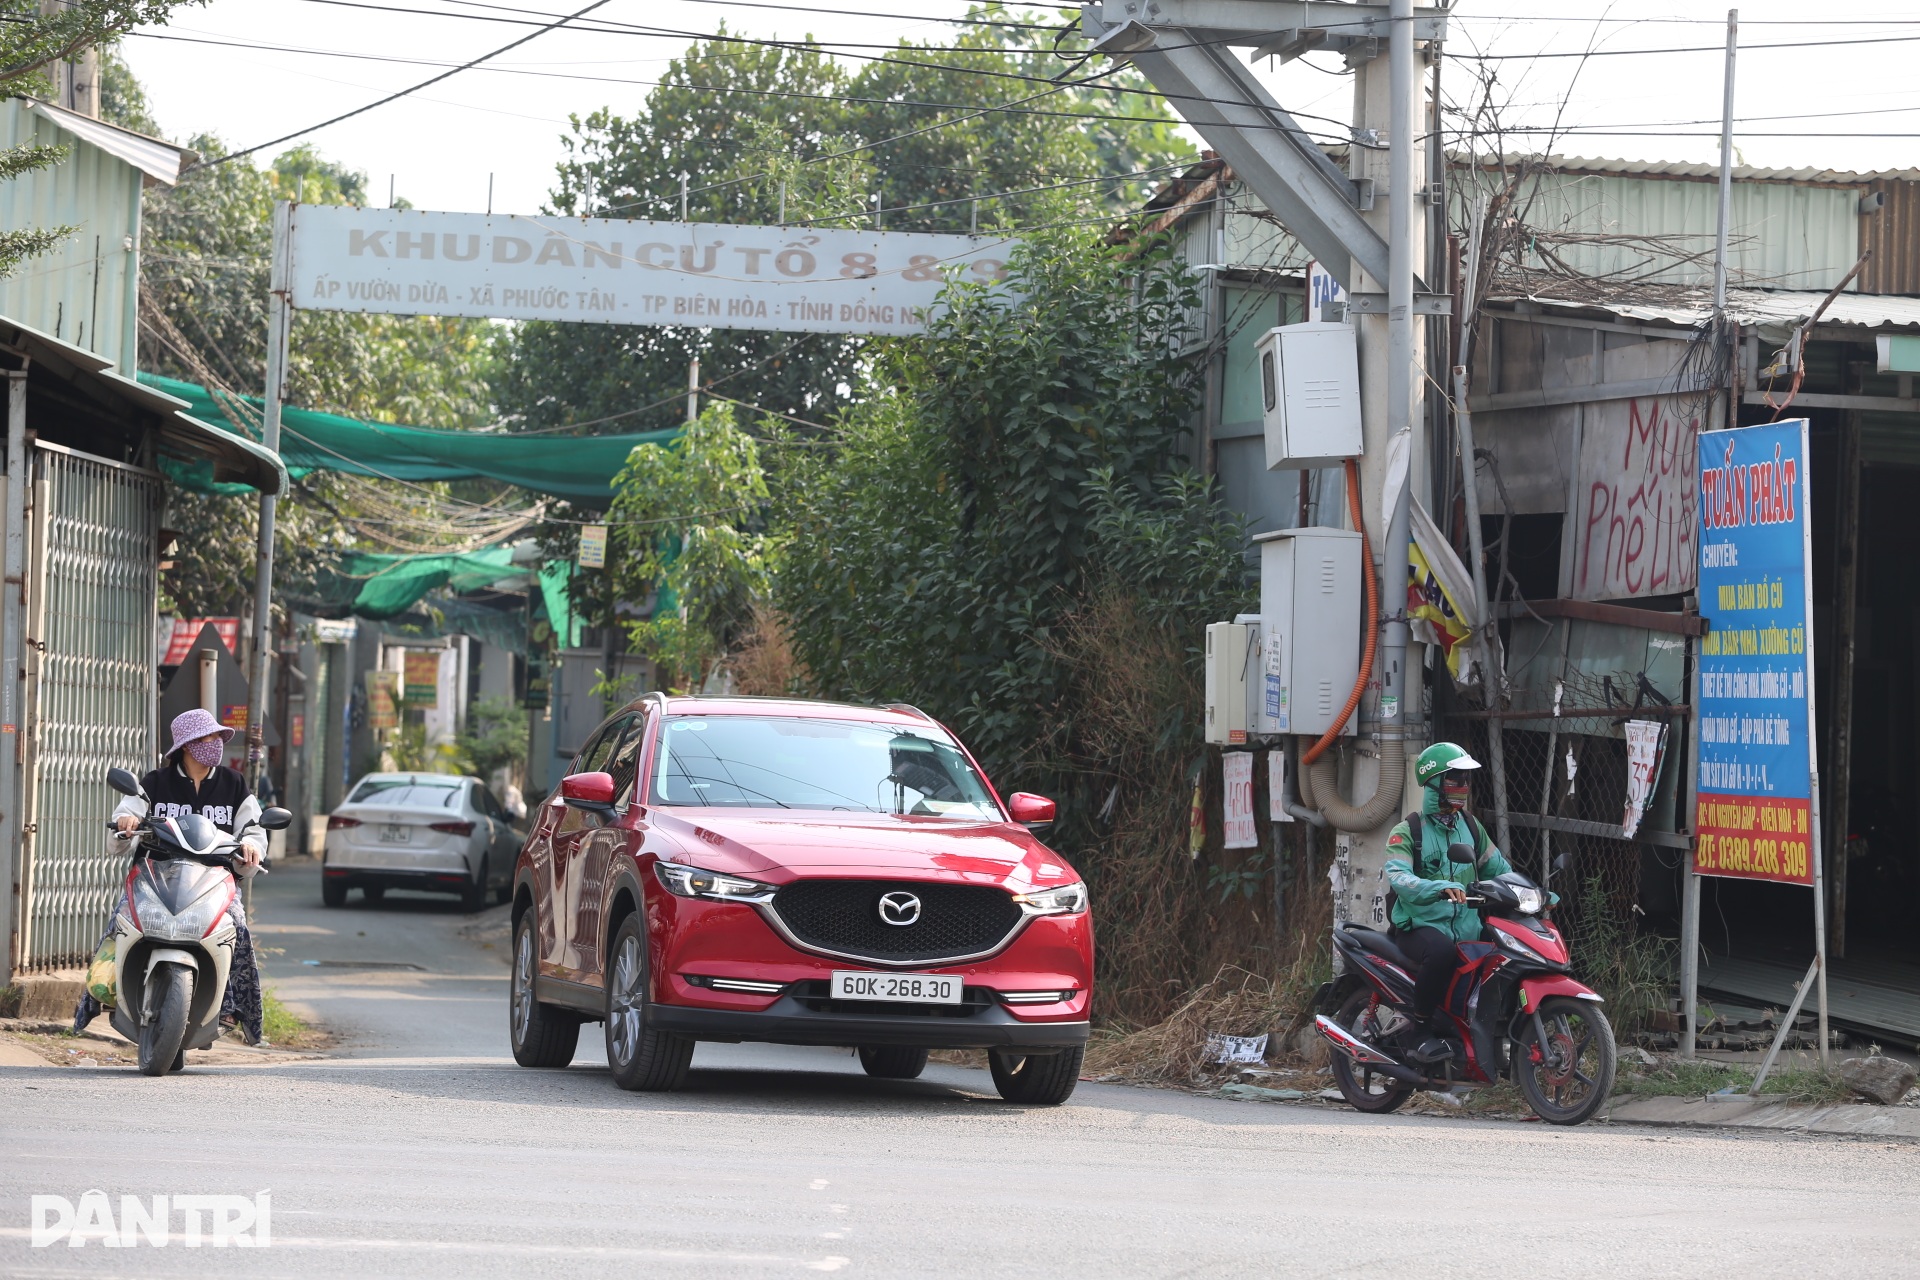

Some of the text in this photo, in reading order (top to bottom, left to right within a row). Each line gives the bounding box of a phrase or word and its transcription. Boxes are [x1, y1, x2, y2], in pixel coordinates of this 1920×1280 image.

[349, 228, 481, 262] KHU
[491, 231, 623, 270] DÂN
[634, 239, 726, 275] CƯ
[733, 236, 821, 278] TỔ
[839, 252, 879, 280] 8
[901, 254, 945, 282] &
[313, 273, 341, 300] ẤP
[347, 277, 401, 303] VƯỜN
[408, 278, 450, 304] DỪA
[469, 282, 495, 307] XÃ
[502, 284, 570, 311] PHƯỚC
[576, 287, 616, 312] TÂN
[641, 294, 668, 314] TP
[673, 292, 721, 317] BIÊN
[727, 293, 768, 319] HÒA
[787, 295, 833, 321] TỈNH
[838, 296, 894, 325] ĐỒNG
[1701, 437, 1796, 531] TUẤN PHÁT
[1702, 538, 1738, 569] CHUYÊN:
[1718, 573, 1783, 611] MUA BÁN ĐỒ CŨ
[1702, 620, 1804, 656] MUA BÁN NHÀ XƯỞNG CŨ
[1702, 664, 1715, 698] THIẾT
[1733, 666, 1747, 699] CÔNG
[1765, 713, 1773, 745] BÊ
[1773, 713, 1790, 746] TÔNG
[1418, 759, 1437, 775] Grab
[1701, 756, 1710, 788] TÔN
[1711, 753, 1720, 788] SẮT
[1708, 799, 1716, 828] VÕ
[1716, 800, 1741, 830] NGUYÊN
[1741, 801, 1756, 831] GIÁP
[1761, 802, 1777, 832] BIÊN
[1778, 801, 1791, 833] HÒA
[1797, 808, 1807, 834] ĐN
[1697, 833, 1807, 878] ĐT: 0389.208 309
[842, 976, 951, 999] 60K-268.30
